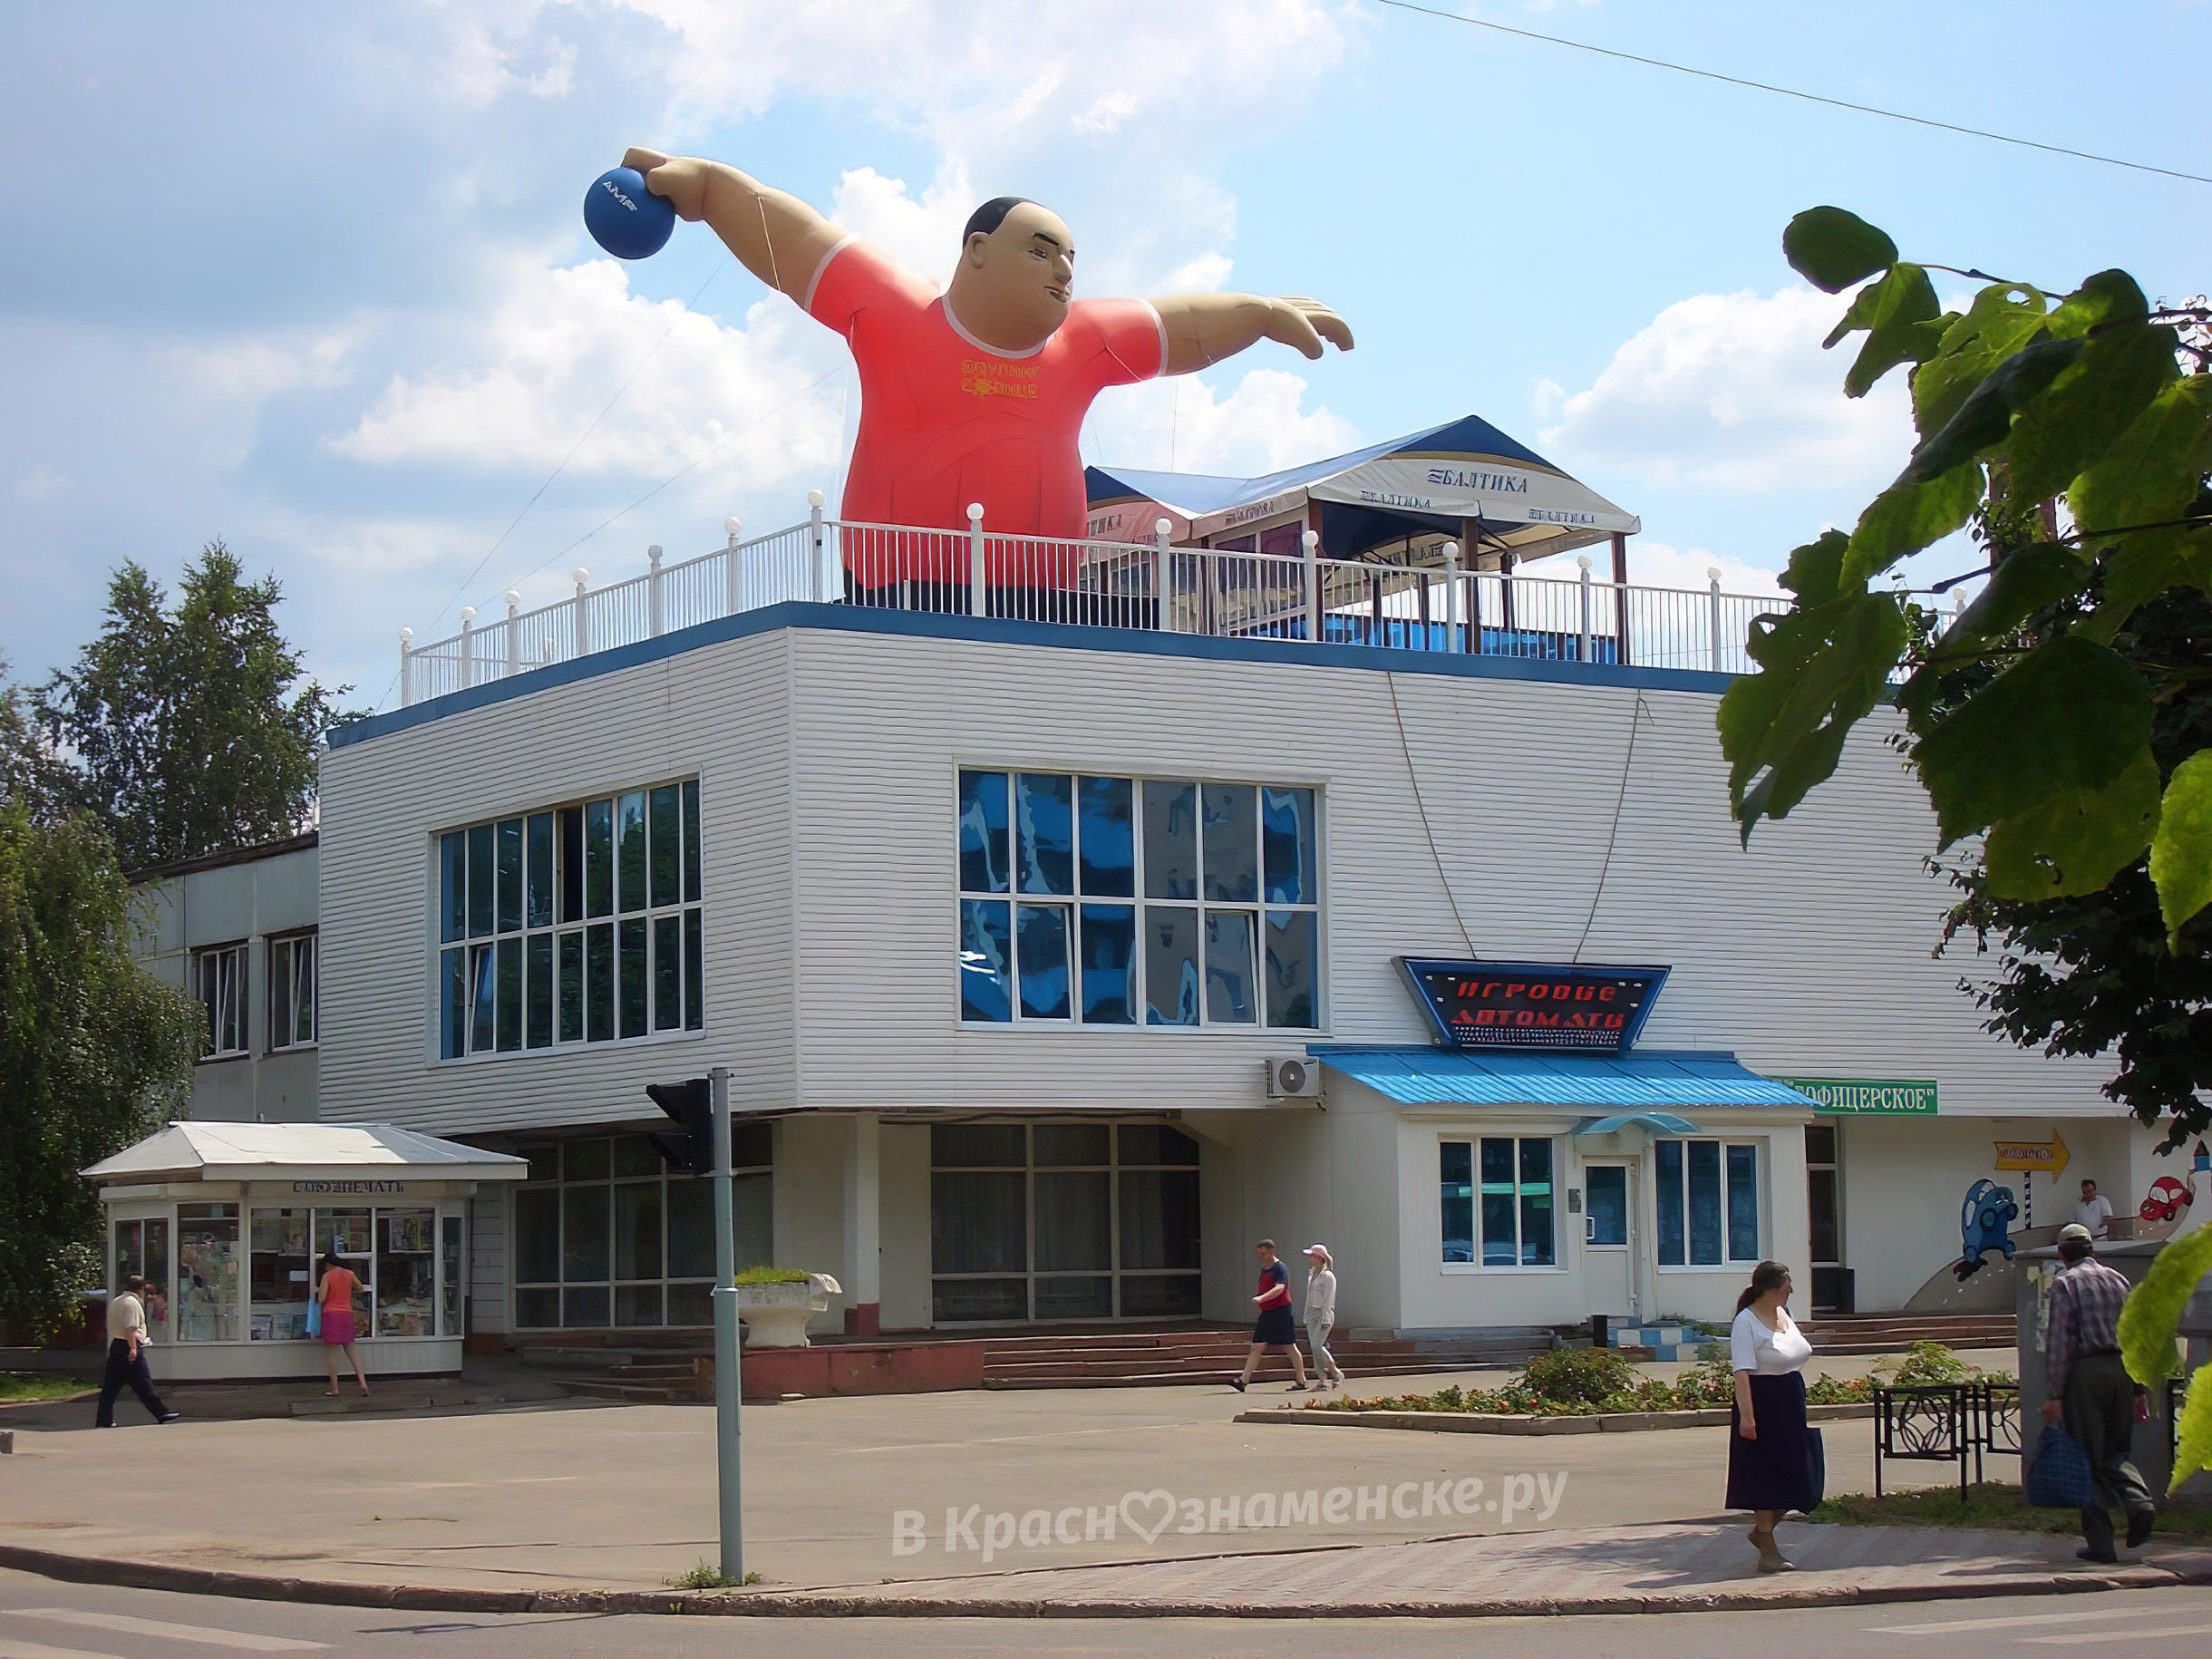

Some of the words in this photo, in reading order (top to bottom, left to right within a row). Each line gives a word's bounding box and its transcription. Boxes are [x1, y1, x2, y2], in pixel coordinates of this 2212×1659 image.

[602, 180, 638, 211] AMF
[1441, 470, 1528, 493] БАЛТИКА
[293, 1181, 404, 1193] СОЮЗПЕЧАТЬ
